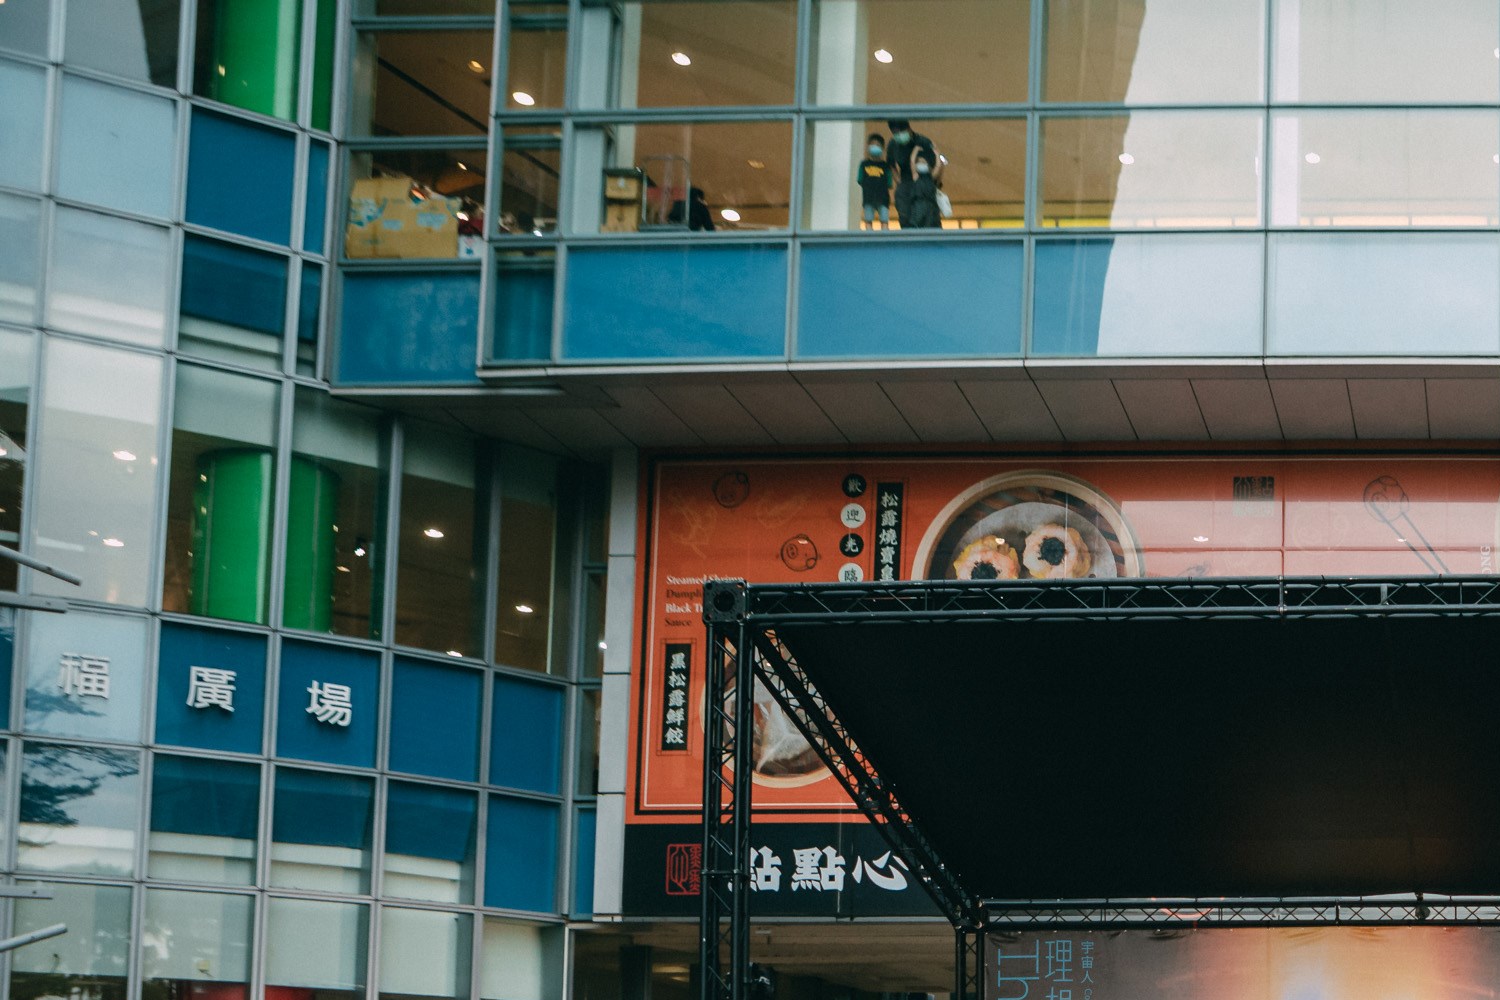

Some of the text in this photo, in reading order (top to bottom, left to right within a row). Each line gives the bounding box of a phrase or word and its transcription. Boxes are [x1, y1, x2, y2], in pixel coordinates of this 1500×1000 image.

[665, 603, 692, 613] Black
[1080, 940, 1095, 984] 宇宙人
